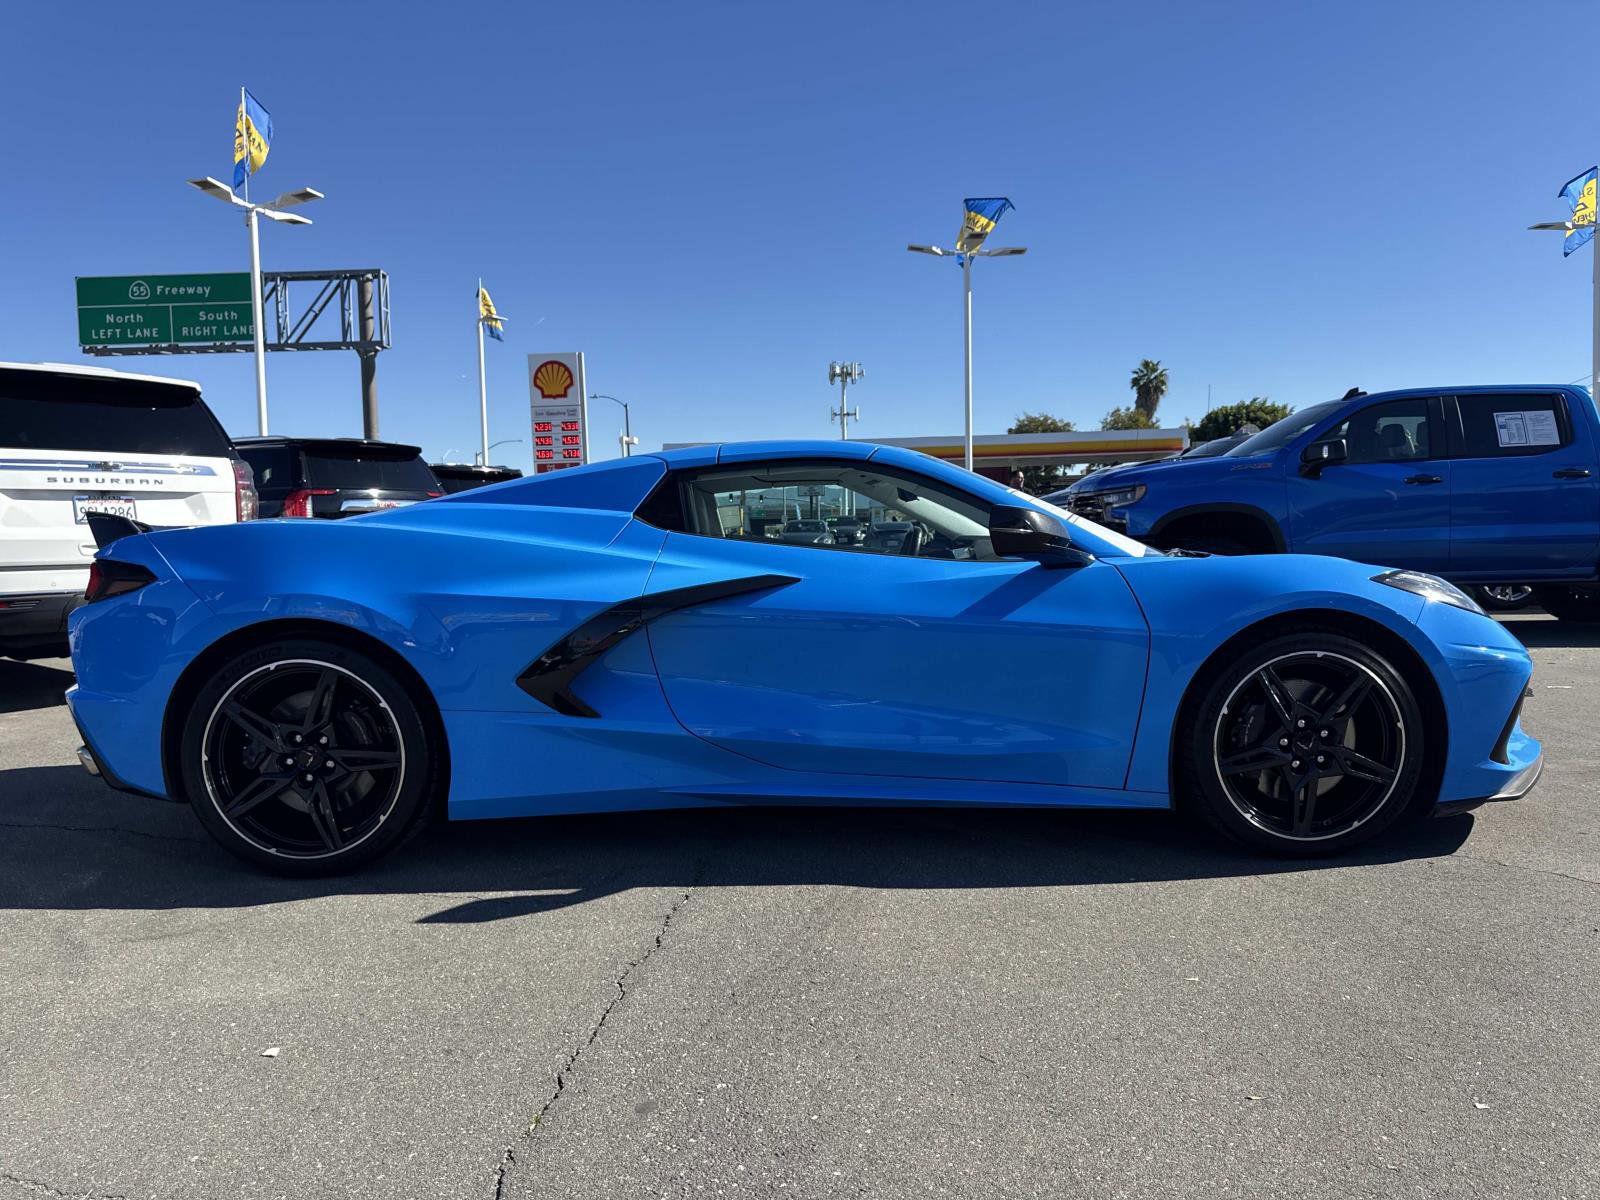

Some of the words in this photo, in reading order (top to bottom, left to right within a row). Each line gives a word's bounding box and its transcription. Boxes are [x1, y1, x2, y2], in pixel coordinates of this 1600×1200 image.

[132, 286, 147, 296] 55
[156, 285, 211, 298] Freeway
[106, 313, 144, 324] North
[199, 310, 238, 321] South
[91, 328, 120, 339] LEFT
[127, 327, 159, 338] LANE
[182, 325, 218, 336] RIGHT
[223, 325, 255, 335] LANE
[47, 477, 164, 485] SUBURBAN
